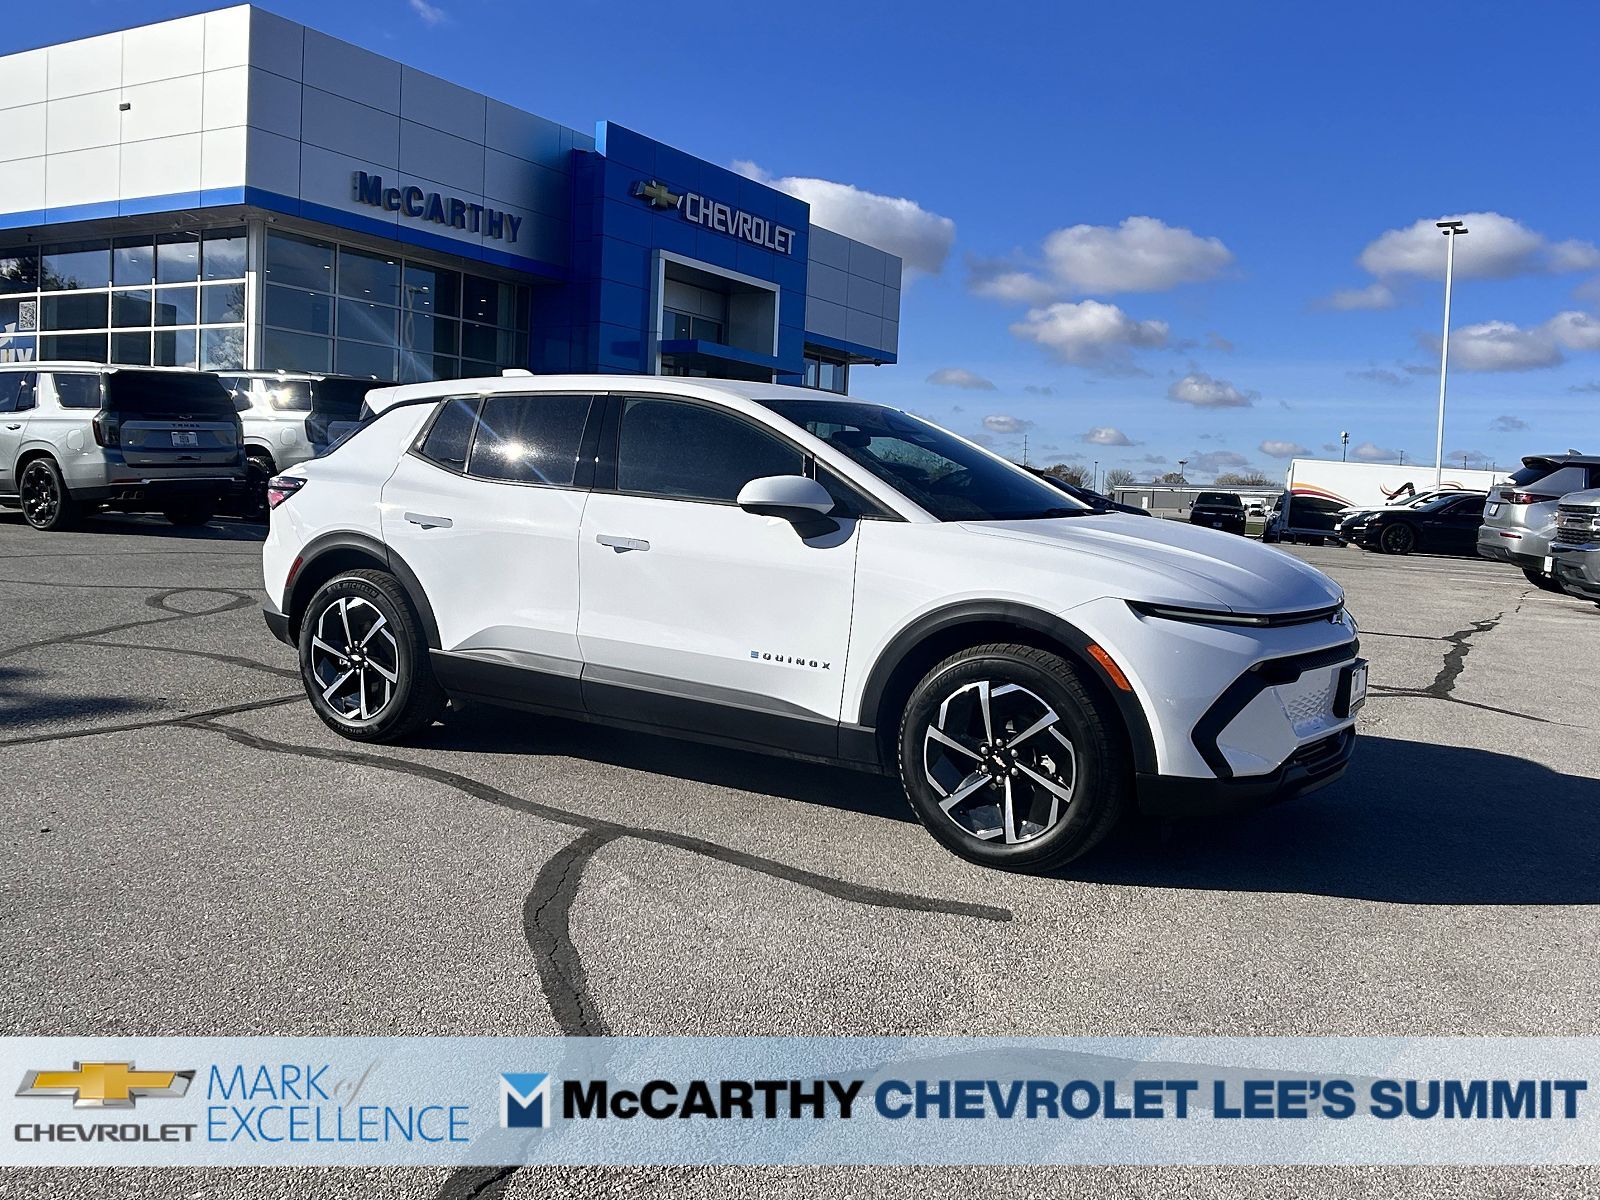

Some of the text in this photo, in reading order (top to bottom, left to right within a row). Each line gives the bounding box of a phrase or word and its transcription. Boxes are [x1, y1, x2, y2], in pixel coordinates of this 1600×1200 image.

[352, 170, 522, 243] McCARTHY
[685, 192, 796, 255] CHEVROLET
[750, 650, 831, 670] EQUINOX
